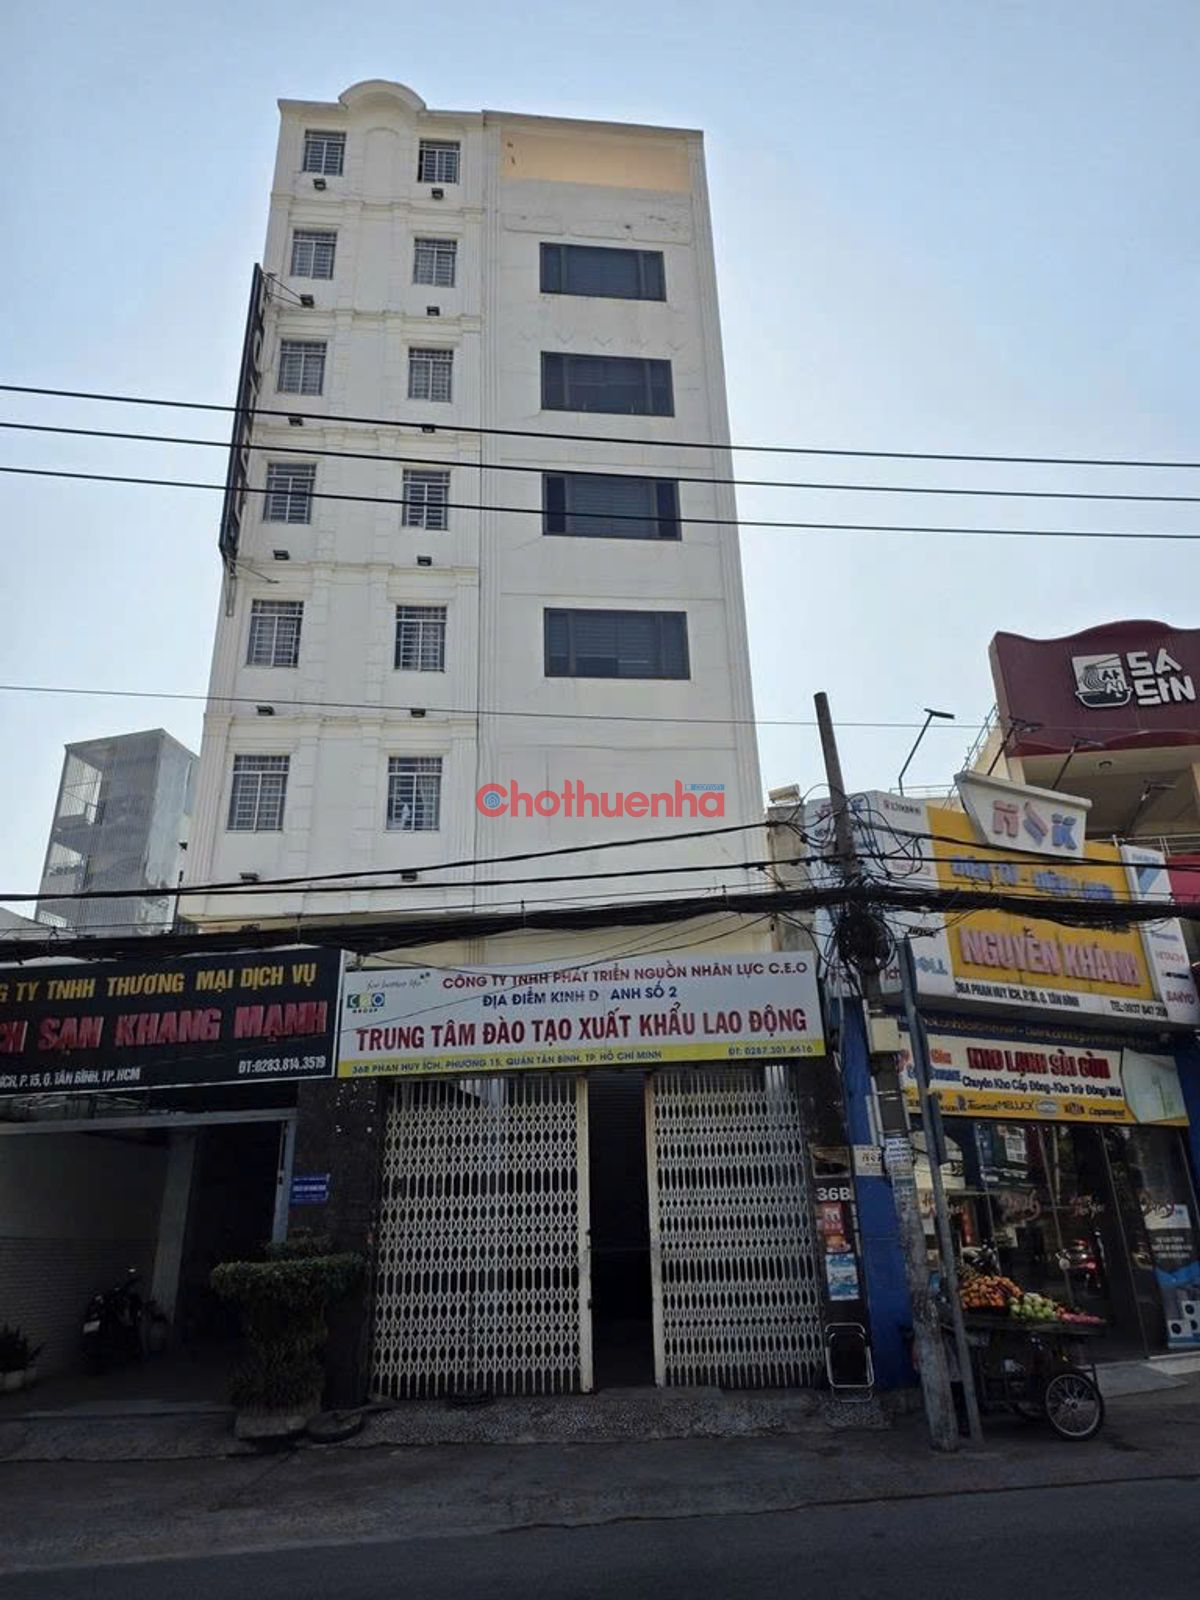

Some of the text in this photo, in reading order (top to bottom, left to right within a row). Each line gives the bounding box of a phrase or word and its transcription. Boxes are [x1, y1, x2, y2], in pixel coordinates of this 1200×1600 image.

[960, 925, 1062, 977] NGUYỄN
[16, 980, 40, 1001] TY
[47, 978, 96, 1000] TNHH
[107, 973, 185, 997] THƯƠNG
[195, 969, 234, 993] MẠI
[240, 966, 284, 990] DỊCH
[292, 963, 317, 987] VỤ
[443, 974, 487, 989] CÔNG
[492, 974, 509, 986] TY
[512, 973, 548, 986] TNHH
[593, 963, 629, 981] TRIỂN
[634, 960, 687, 979] NGUỒN
[691, 962, 732, 977] NHÂN
[737, 962, 764, 977] LỰC
[769, 962, 808, 974] C.E.O
[483, 981, 677, 1009] ĐỊA ĐIỂM KINH DANH SỐ 2
[38, 1015, 105, 1055] SẠN
[115, 1007, 222, 1046] KHANG
[234, 1000, 328, 1042] MẠNH
[356, 1002, 808, 1051] TRUNG TÂM ĐÀO TẠO XUẤT KHẨU LAO ĐỘNG
[372, 1061, 399, 1073] PHAN
[535, 1052, 555, 1064] TÂN
[600, 1048, 615, 1061] HỒ
[617, 1049, 635, 1060] CHÍ
[636, 1049, 662, 1060] MINH
[966, 1047, 1004, 1071] KHO
[817, 1187, 851, 1201] 36B
